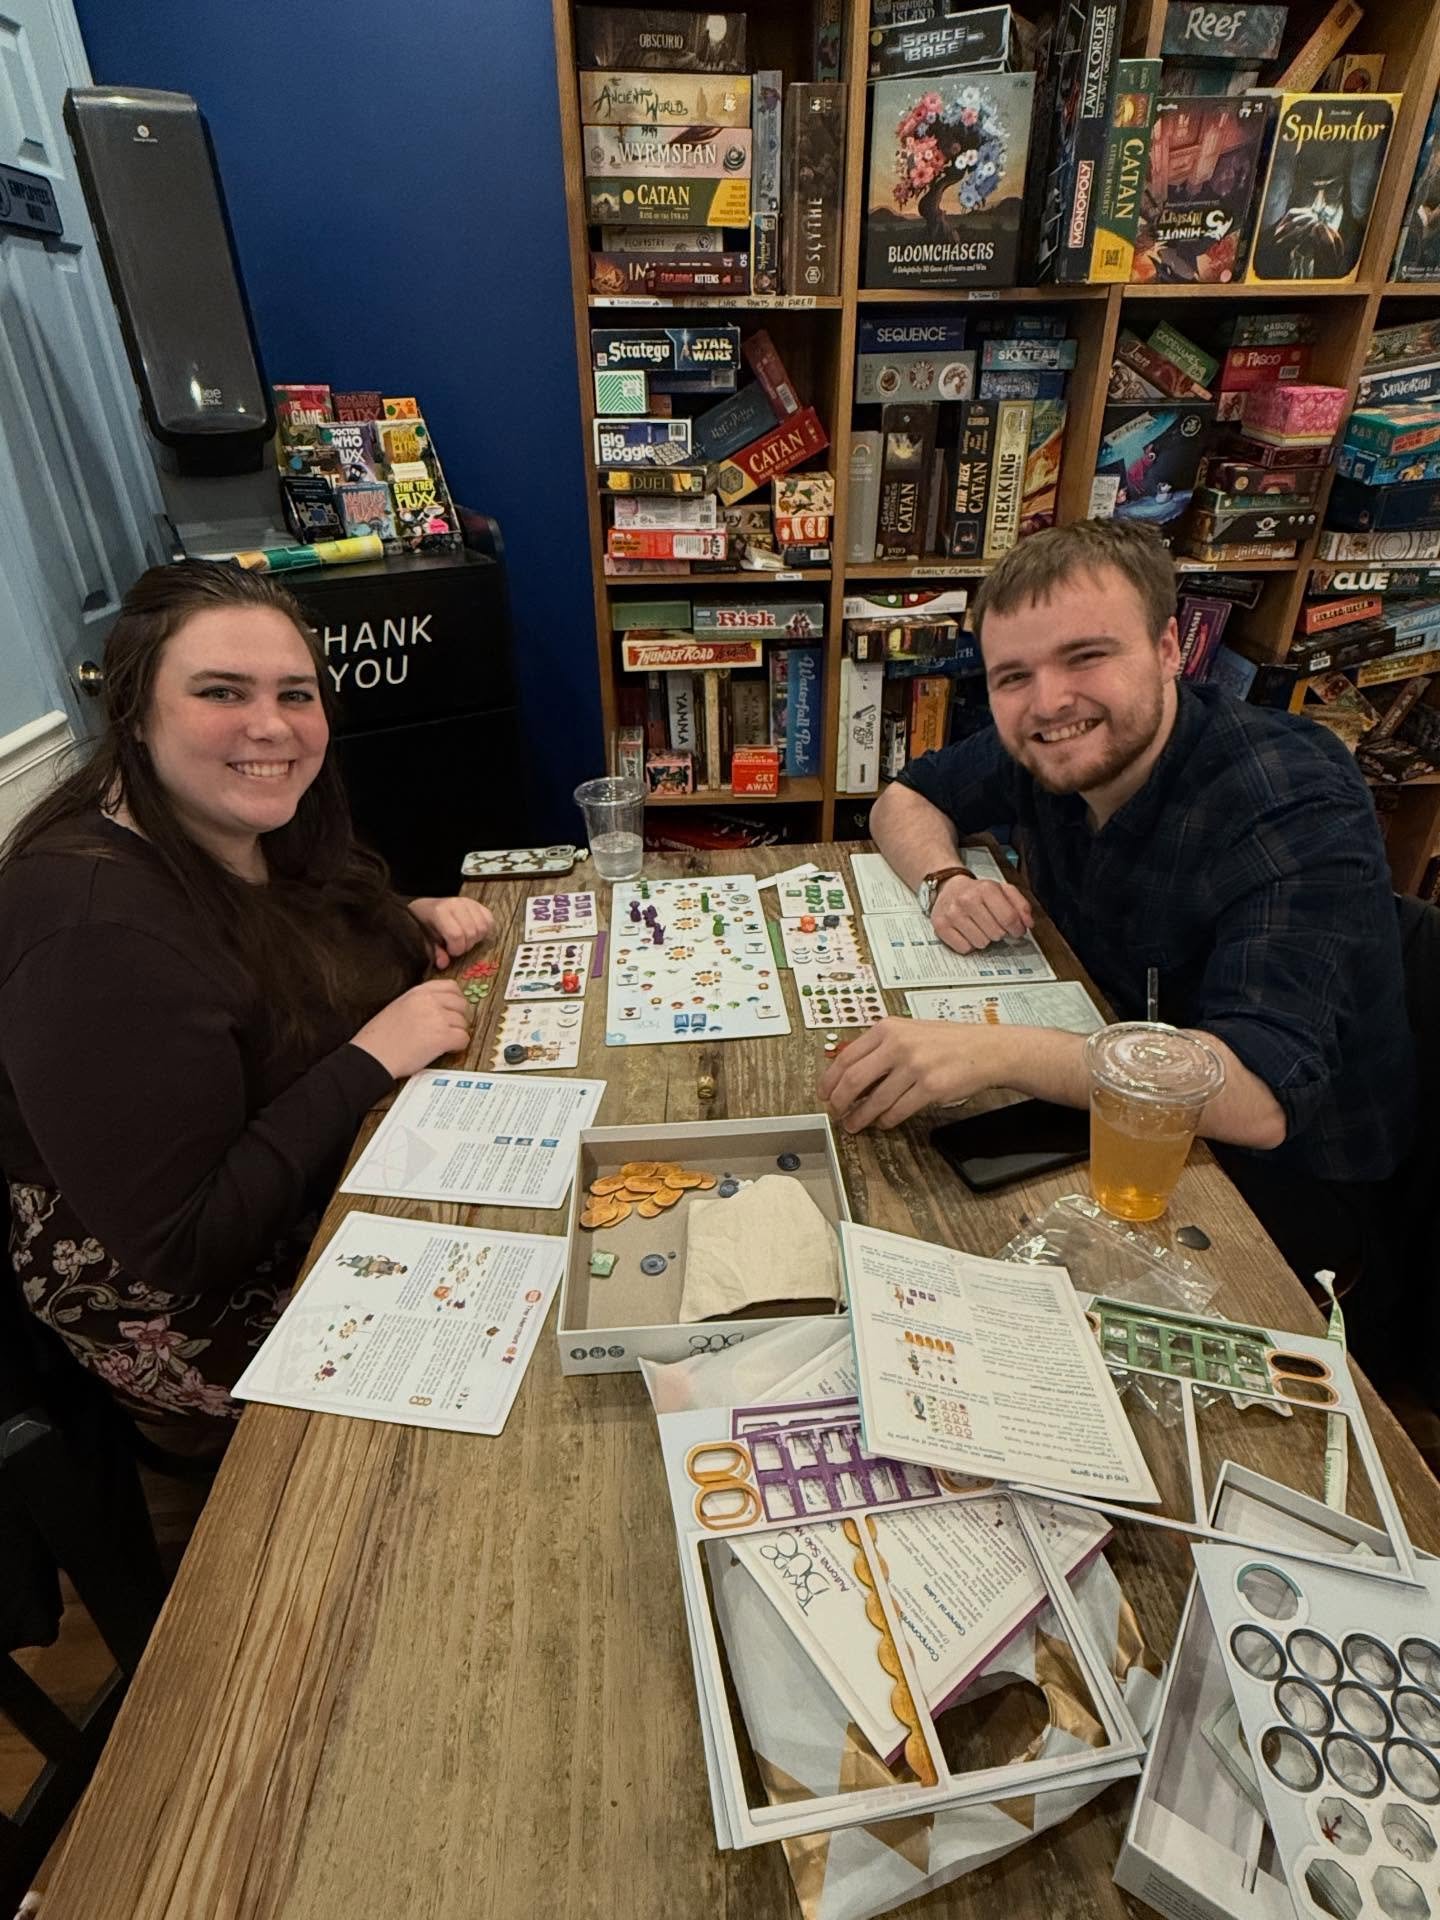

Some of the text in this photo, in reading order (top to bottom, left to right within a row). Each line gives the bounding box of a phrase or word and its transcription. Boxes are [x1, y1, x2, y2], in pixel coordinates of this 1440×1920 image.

[1186, 7, 1246, 41] Reef
[639, 34, 683, 49] OBSCURIO
[903, 27, 967, 48] SPACE
[906, 42, 959, 61] BASE
[1084, 7, 1107, 119] LAW & ORDER
[592, 86, 652, 118] ANCIENT
[646, 94, 688, 121] WORLD
[1282, 108, 1388, 154] Splendor
[619, 143, 718, 164] WYRMSPAN
[1115, 137, 1145, 221] CATAN
[637, 184, 690, 205] CATAN
[1072, 163, 1093, 245] MONOPOLY
[888, 242, 994, 262] BLOOMCHASERS
[660, 272, 693, 284] EXPLODING
[694, 273, 720, 285] KITTENS
[692, 338, 733, 350] STAR
[877, 327, 947, 343] SEQUENCE
[608, 342, 670, 362] Stratego
[692, 349, 733, 361] WARS
[998, 350, 1059, 361] SKY TEAM
[1155, 329, 1200, 367] CODENAMES
[1380, 375, 1432, 399] SANTORINI
[291, 409, 322, 425] GAME
[332, 436, 363, 447] WHO
[600, 433, 625, 448] Big
[749, 428, 805, 473] CATAN
[601, 444, 655, 462] Boggle
[415, 479, 434, 492] TREK
[632, 476, 667, 490] DUEL
[954, 463, 971, 513] STAR TREK
[967, 461, 990, 514] CATAN
[396, 491, 438, 510] FLUXX
[992, 453, 1017, 534] TREKKING
[881, 497, 890, 525] GAME
[888, 483, 899, 533] THRONES
[897, 483, 915, 533] CATAN
[1235, 544, 1272, 558] JAIPUR
[916, 567, 945, 575] FAMILY
[1333, 572, 1390, 591] CLUE
[716, 610, 776, 628] Risk
[310, 614, 432, 656] HANK
[638, 648, 682, 665] THUNDER
[684, 646, 714, 661] ROAD
[328, 655, 408, 692] YOU
[676, 693, 689, 745] YAMMA
[794, 656, 816, 768] Waterfall Park
[746, 783, 774, 791] AWAY
[755, 774, 774, 782] GET
[1070, 1465, 1090, 1478] game
[1091, 1471, 1104, 1481] the
[1114, 1474, 1129, 1485] End
[802, 1536, 850, 1595] Automa Solo
[922, 1583, 967, 1638] General rules
[898, 1610, 941, 1663] Components
